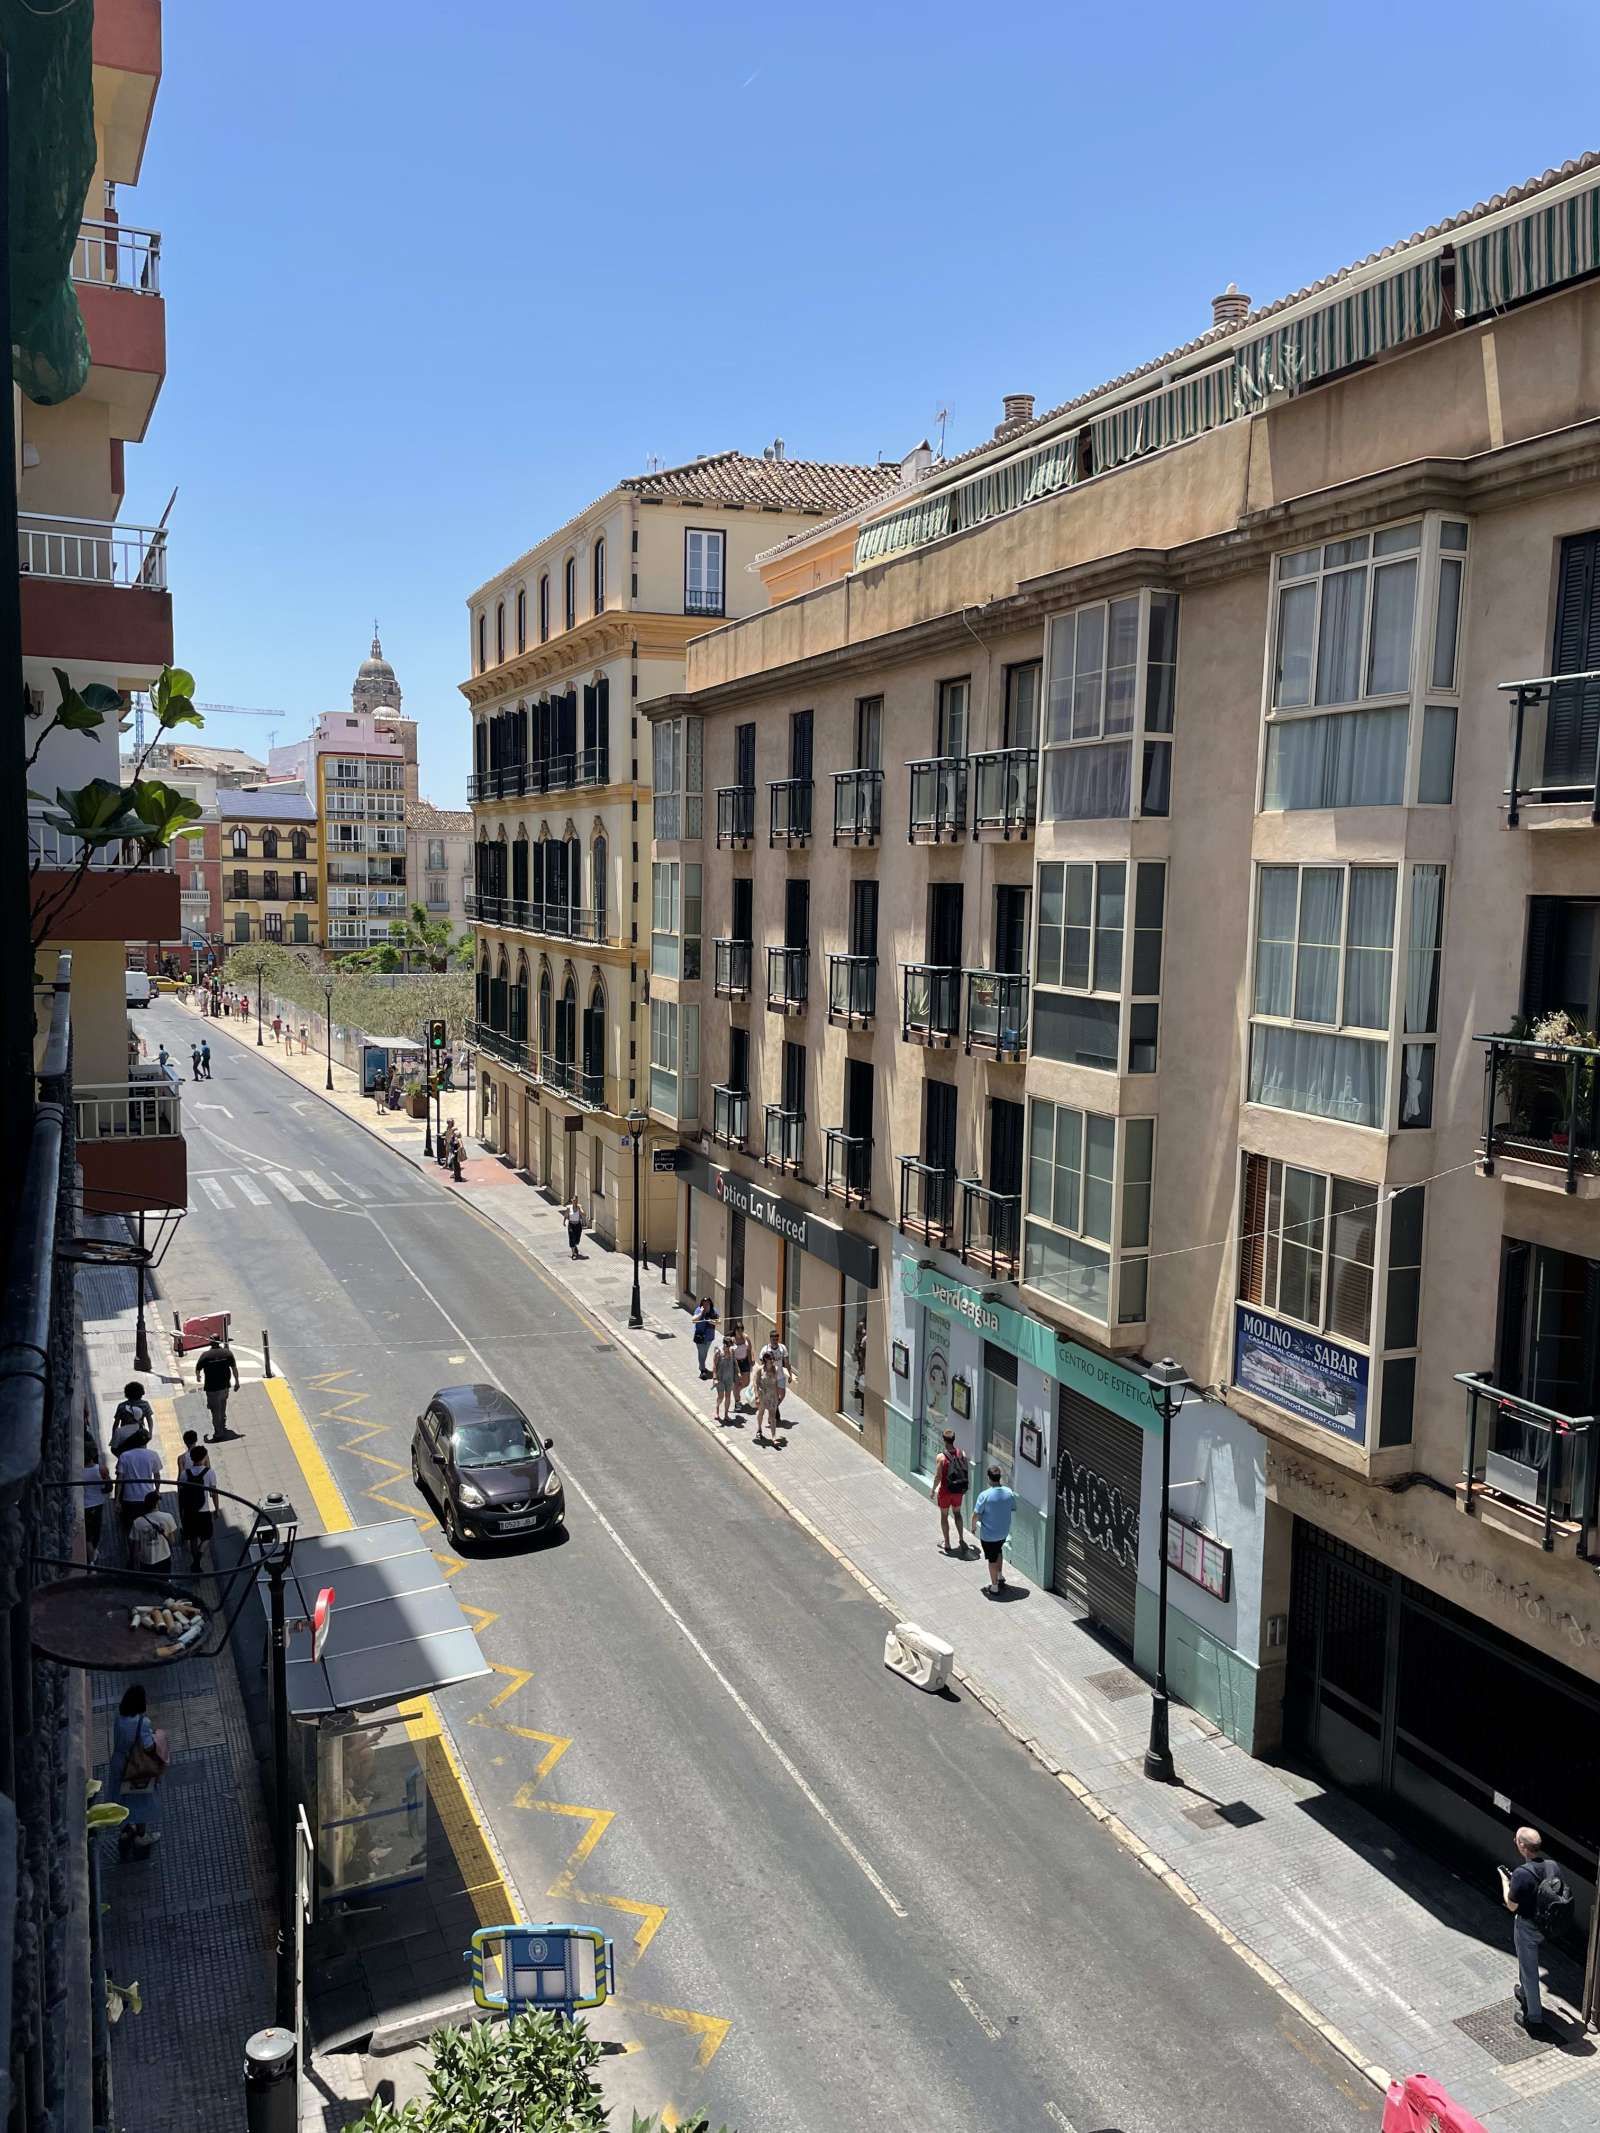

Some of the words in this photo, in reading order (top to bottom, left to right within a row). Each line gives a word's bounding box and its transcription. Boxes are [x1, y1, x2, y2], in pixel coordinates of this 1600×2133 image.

[715, 1172, 747, 1210] Óptica
[749, 1193, 763, 1219] La
[766, 1202, 806, 1243] Merced
[931, 1282, 1000, 1332] verdeagua
[1243, 1313, 1292, 1350] MOLINO
[1314, 1343, 1359, 1379] SABAR
[1248, 1335, 1265, 1347] CASA
[1265, 1341, 1285, 1355] RURAL
[1286, 1351, 1300, 1361] CON
[1301, 1356, 1319, 1370] PISTA
[1319, 1364, 1329, 1374] DE
[1060, 1348, 1095, 1377] CENTRO
[1097, 1368, 1110, 1385] DE
[1111, 1376, 1153, 1409] ESTÉTICA
[1249, 1382, 1347, 1433] www.molinodesabar.com
